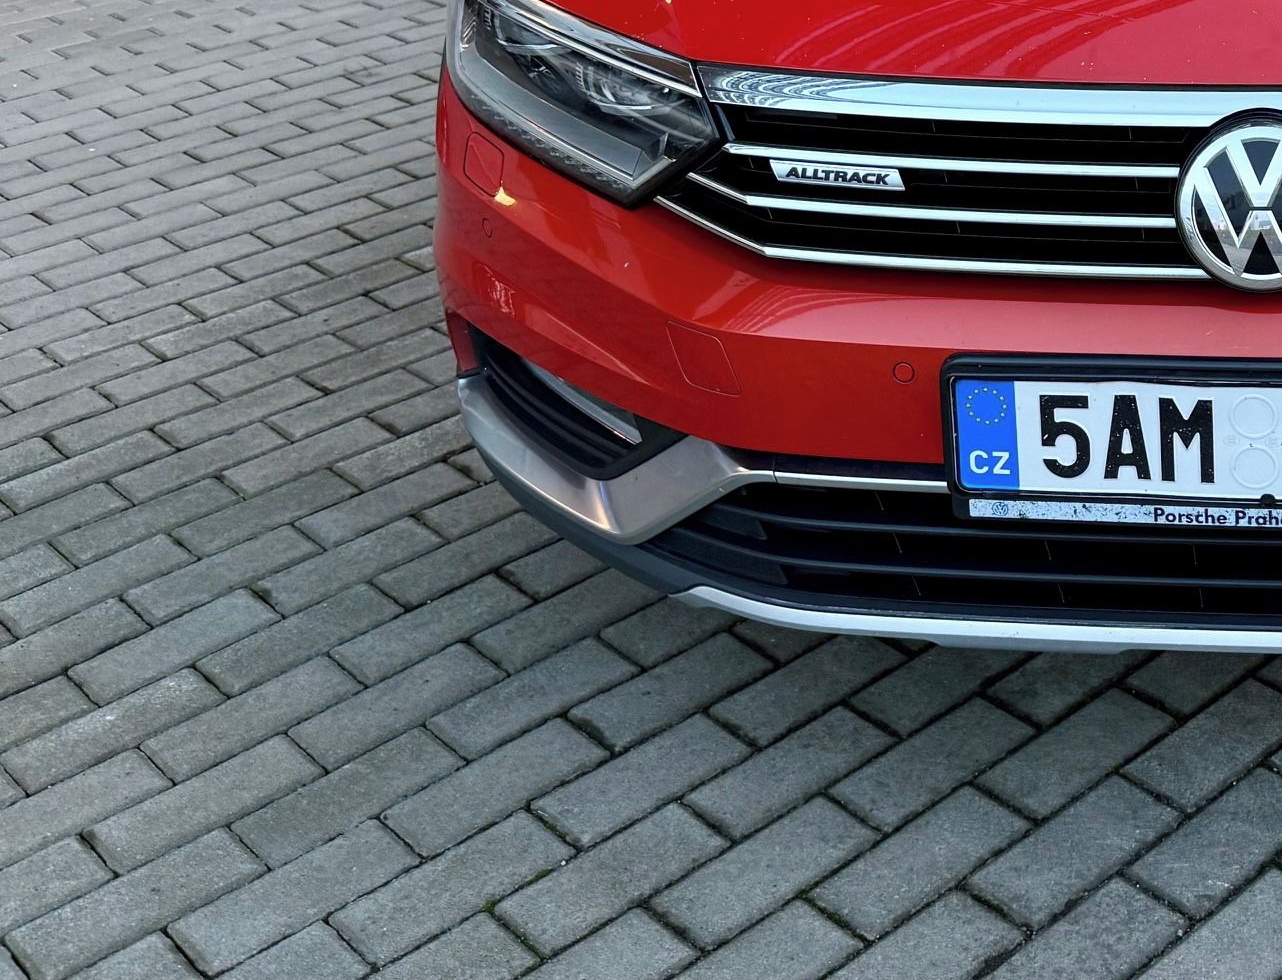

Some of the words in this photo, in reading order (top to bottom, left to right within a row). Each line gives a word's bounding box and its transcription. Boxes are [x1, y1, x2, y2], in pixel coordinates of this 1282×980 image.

[786, 166, 890, 186] ALLTRACK
[1039, 394, 1216, 484] 5AM
[968, 449, 1011, 475] CZ
[1153, 507, 1227, 525] Porsche
